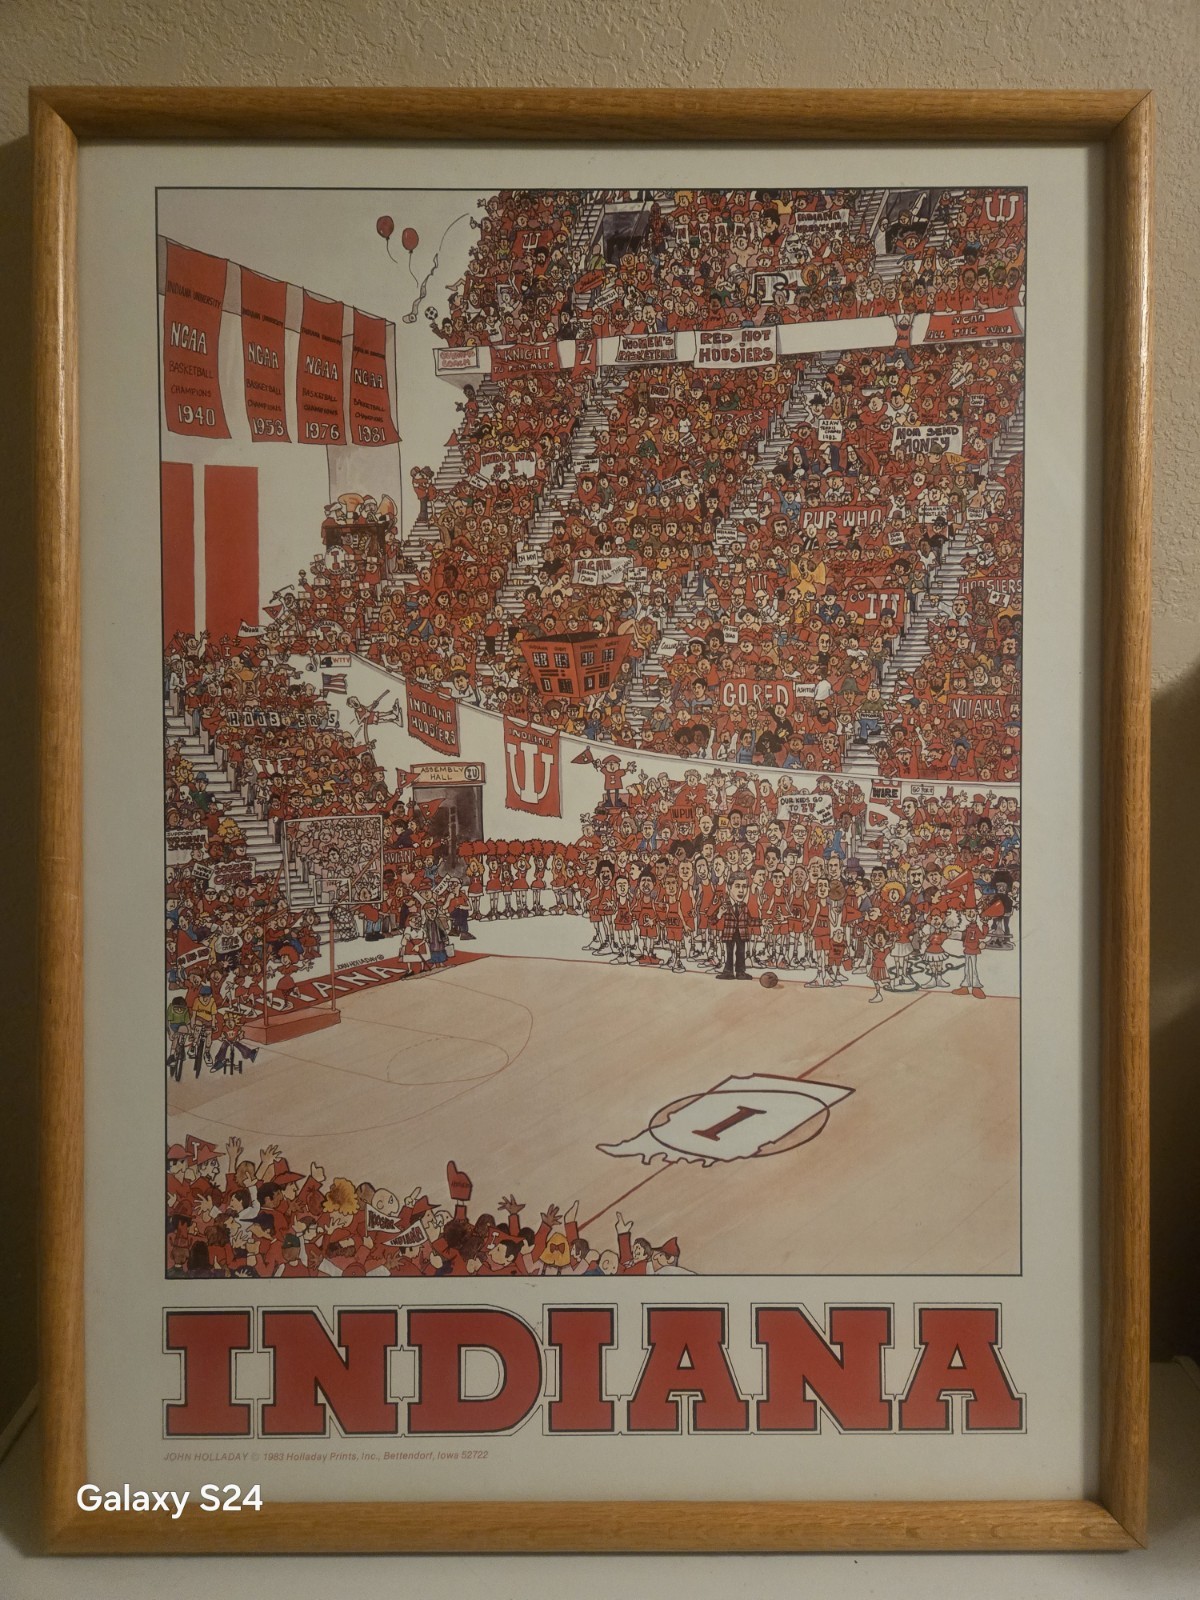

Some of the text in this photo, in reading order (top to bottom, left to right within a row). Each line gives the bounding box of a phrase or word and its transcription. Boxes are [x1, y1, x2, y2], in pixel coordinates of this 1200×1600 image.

[171, 320, 208, 355] NCAA
[622, 336, 674, 349] WOMEN'S
[700, 330, 772, 345] RED HOT
[248, 342, 279, 371] NCAA
[504, 347, 550, 361] KNIGHT
[699, 342, 773, 363] HOOSIERS
[169, 360, 214, 379] BASKETBALL
[305, 355, 338, 381] NCAA
[246, 378, 282, 396] BASKETBALL
[354, 368, 384, 389] NCAA
[171, 384, 212, 397] CHAMPIONS
[302, 387, 337, 402] BASKETBALL
[178, 403, 216, 426] 1940
[247, 398, 282, 412] CHAMPIONS
[253, 418, 285, 437] 1953
[305, 422, 339, 440] 1976
[358, 424, 386, 443] 1981
[896, 427, 959, 440] MOM SEND
[482, 452, 535, 466] INDIANA
[723, 682, 789, 711] GO RED
[409, 697, 451, 723] INDIANA
[948, 698, 1002, 719] INDIANA
[411, 716, 456, 746] HOOSIERS
[509, 728, 552, 748] INDIANA
[435, 877, 450, 894] SWIM
[335, 962, 349, 970] JOHN
[162, 1304, 1026, 1439] INDIANA
[164, 1452, 191, 1461] JOHN
[193, 1452, 248, 1461] HOLLADAY
[264, 1452, 284, 1461] 1983
[286, 1451, 327, 1462] Holladay
[330, 1451, 360, 1462] Prints,
[362, 1451, 381, 1461] Inc.,
[384, 1450, 435, 1462] Bettendorf,
[438, 1451, 459, 1461] Iowa
[462, 1450, 489, 1460] 52722
